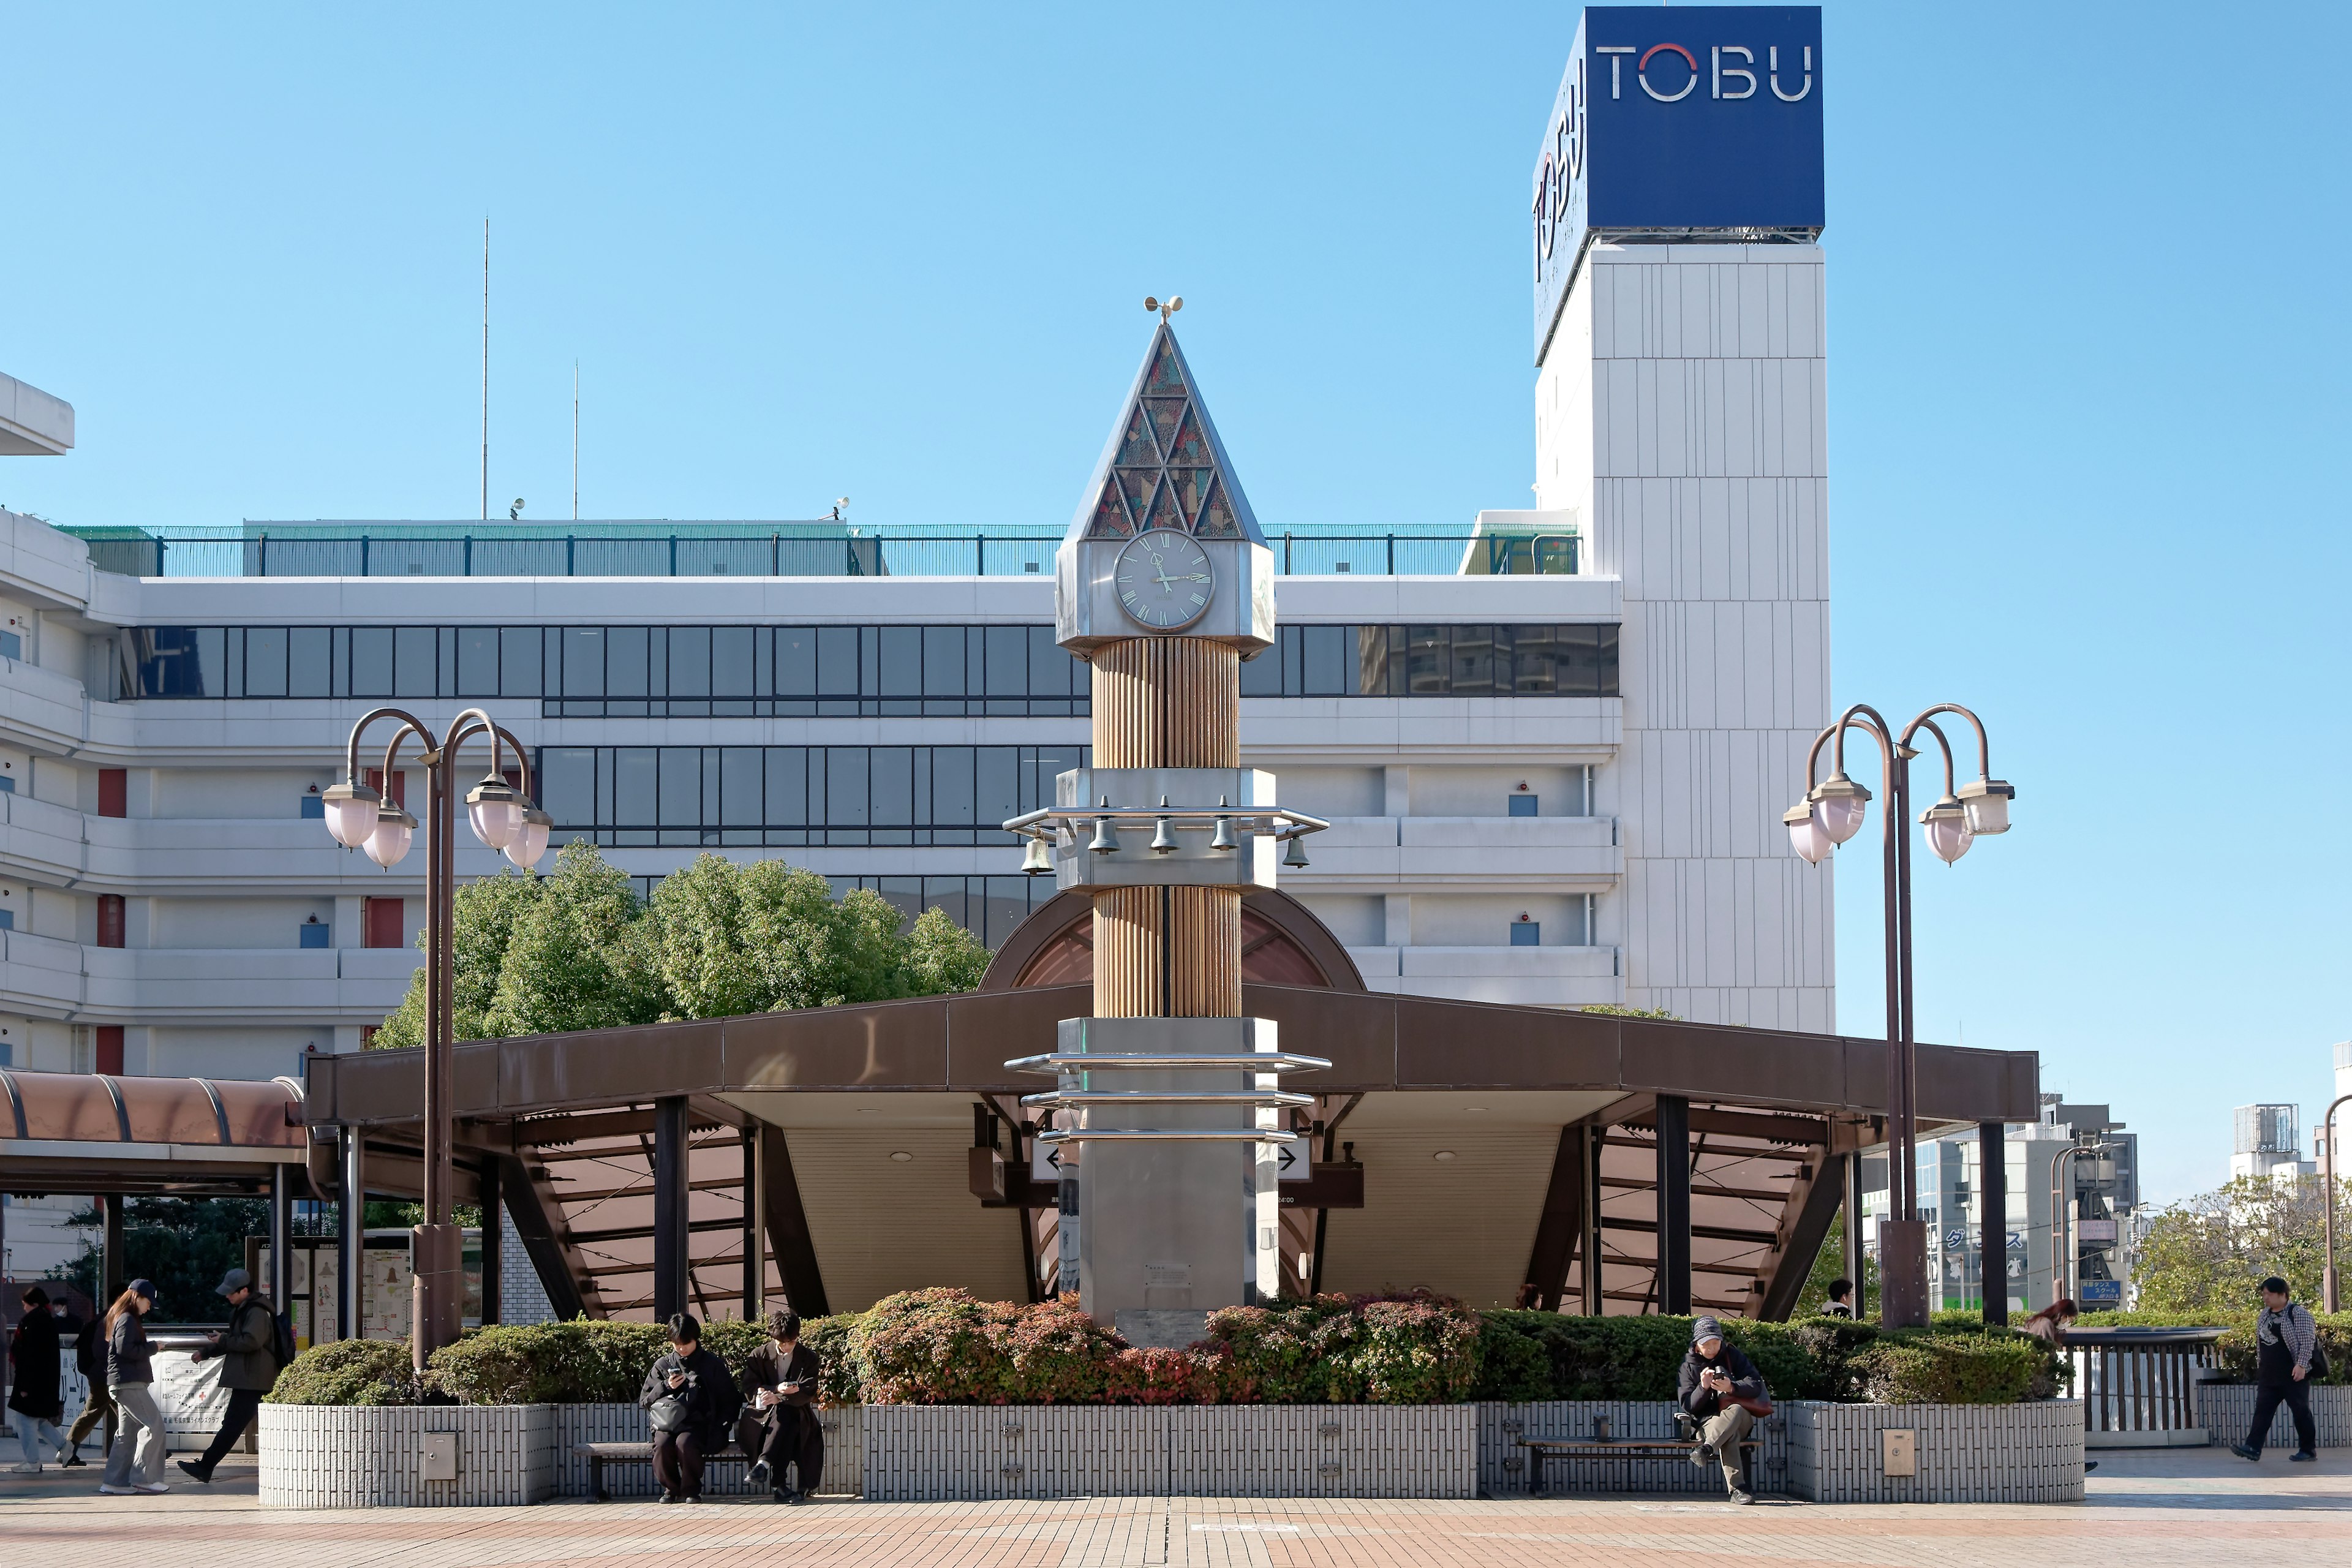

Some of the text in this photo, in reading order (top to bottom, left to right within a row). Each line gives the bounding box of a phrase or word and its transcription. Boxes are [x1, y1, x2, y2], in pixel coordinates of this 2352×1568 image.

[1596, 43, 1812, 102] TOBU
[1532, 58, 1584, 282] TOBU
[1160, 533, 1169, 548] XII
[1946, 1228, 2022, 1248] ダス
